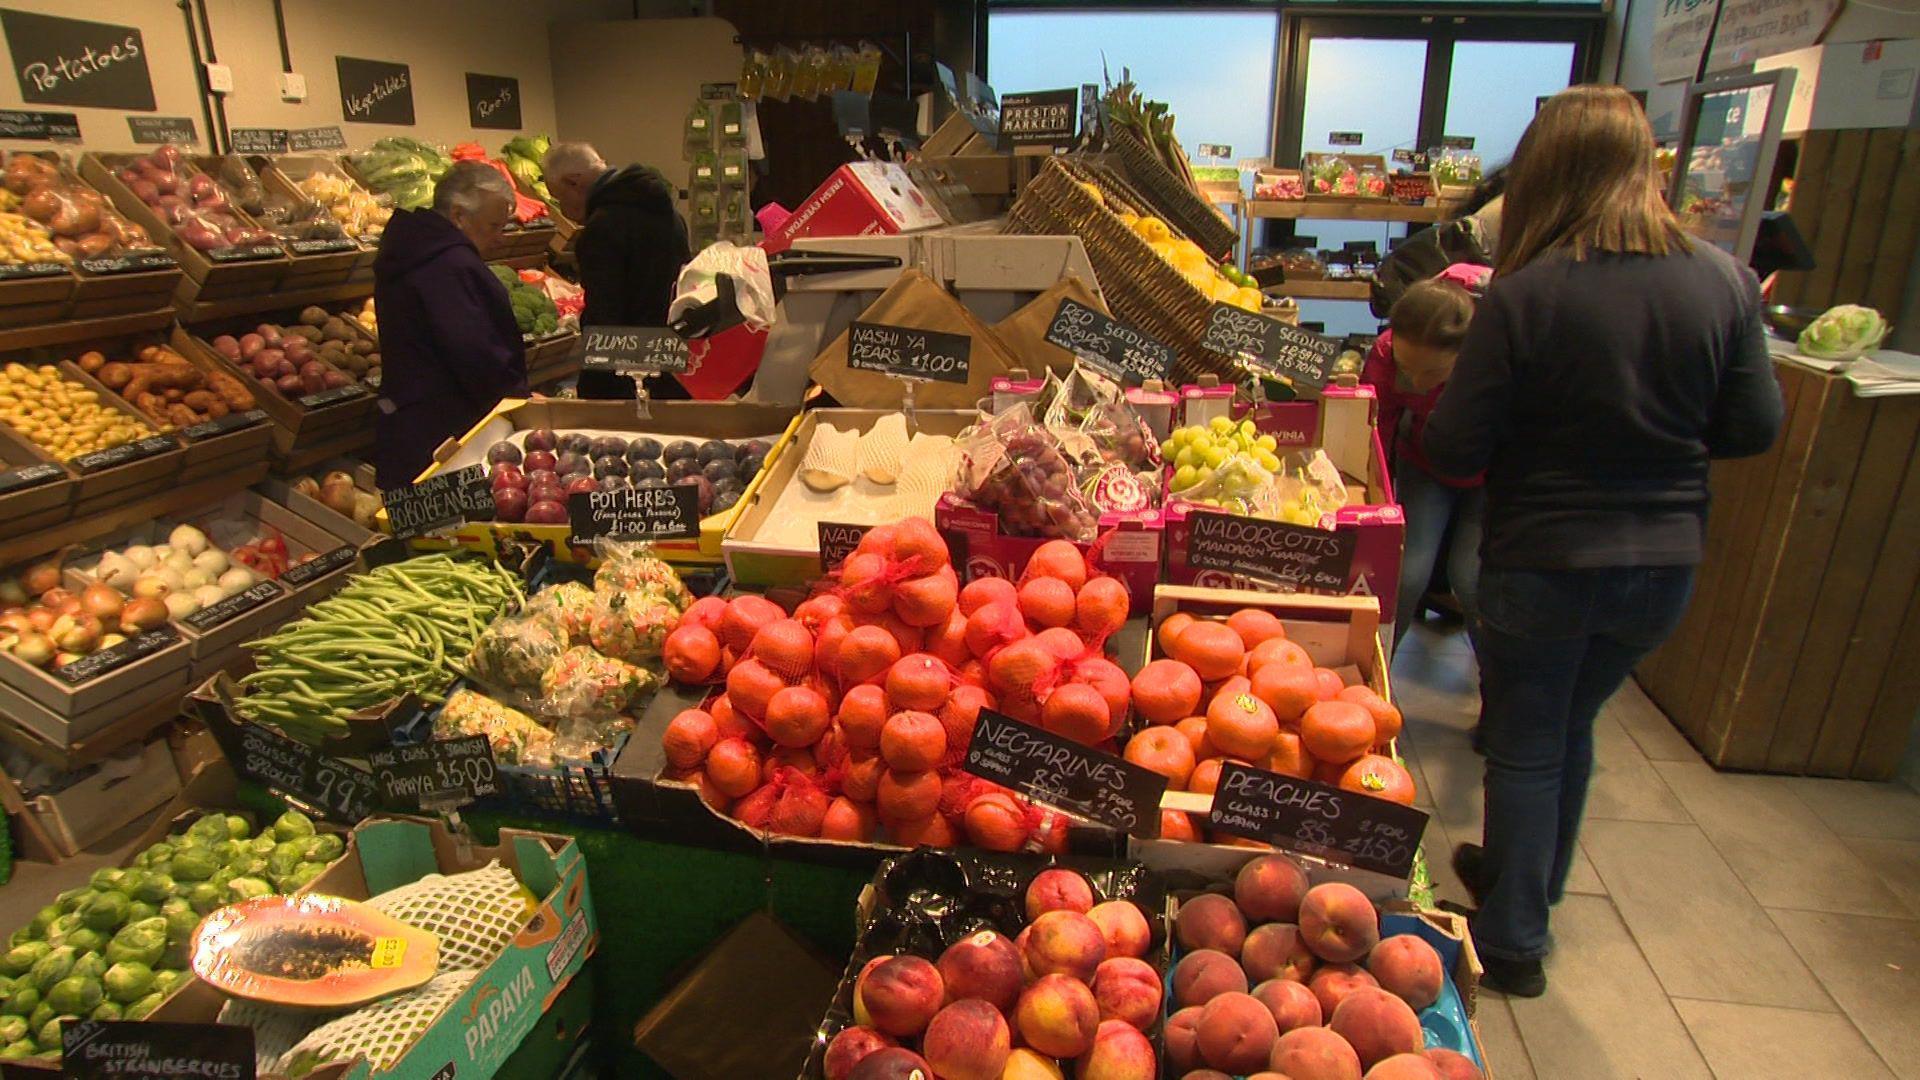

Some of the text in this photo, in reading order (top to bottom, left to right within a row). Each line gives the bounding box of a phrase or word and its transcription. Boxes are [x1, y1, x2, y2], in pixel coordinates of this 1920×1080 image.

[24, 35, 139, 93] Potatoes
[346, 73, 407, 118] Vegetables
[477, 89, 511, 119] Roots
[1006, 106, 1067, 119] PRESTON
[784, 179, 844, 239] FRESH EVERYDAY
[1061, 303, 1094, 326] RED
[1212, 307, 1272, 336] GREEN
[585, 334, 638, 352] PLUMS
[853, 328, 926, 351] NASHI YA
[1053, 319, 1113, 355] GRAPES
[1207, 324, 1336, 355] GRAPES SEEDLESS
[852, 343, 901, 365] PEARS
[589, 486, 677, 509] POT HERBS
[1194, 518, 1340, 557] NADORCOTTS
[976, 719, 1127, 791] NECTARINES
[380, 770, 434, 797] PAPAYA
[1031, 768, 1069, 797] 85p
[1223, 770, 1342, 819] PEACHES
[1296, 819, 1336, 845] 85p
[465, 965, 535, 1061] PAPAYA
[86, 1041, 150, 1058] BRITISH
